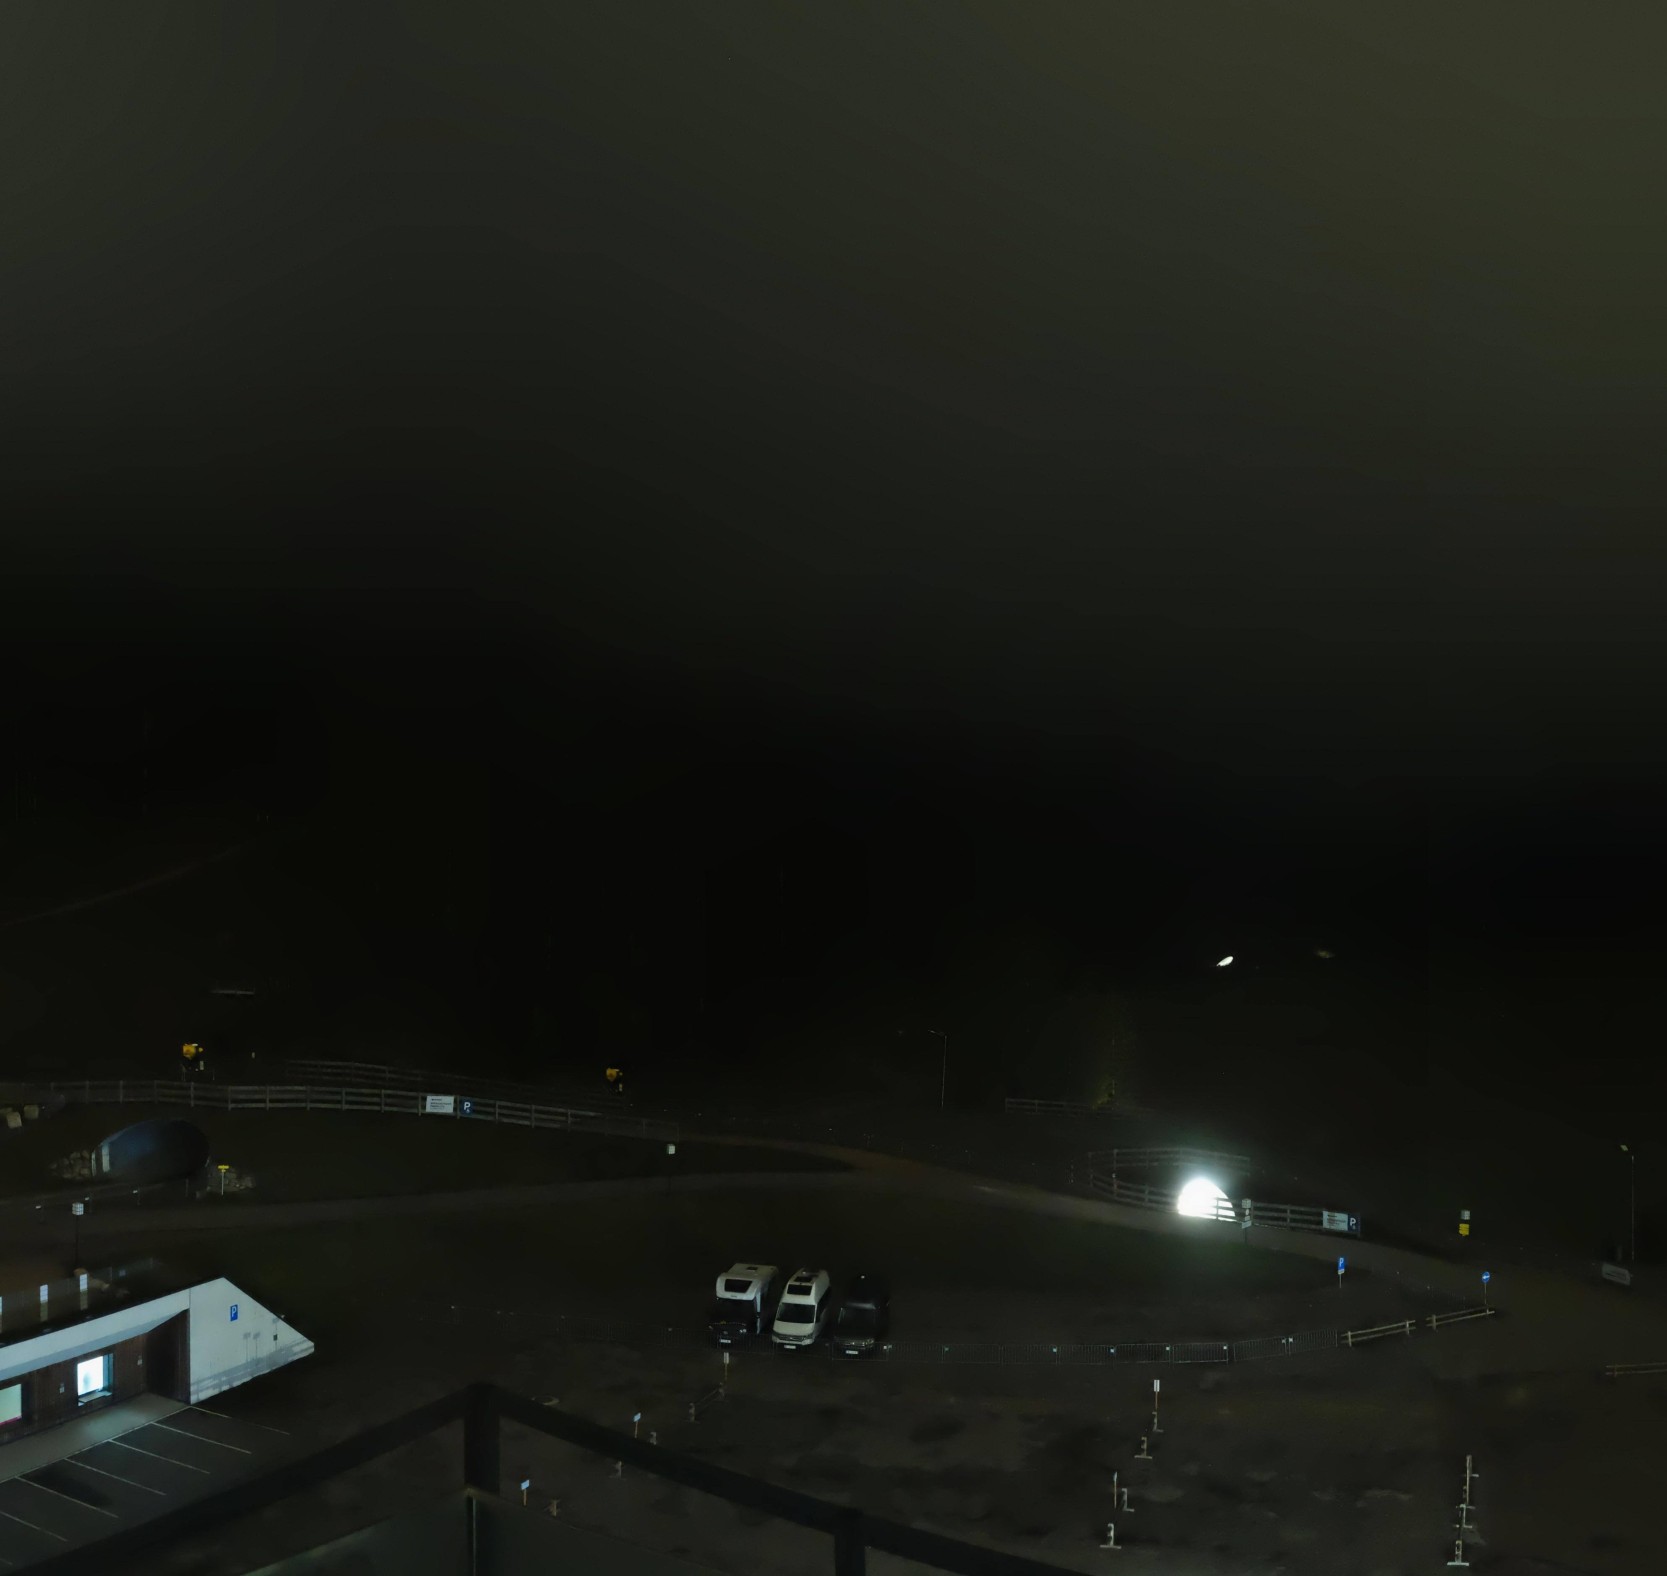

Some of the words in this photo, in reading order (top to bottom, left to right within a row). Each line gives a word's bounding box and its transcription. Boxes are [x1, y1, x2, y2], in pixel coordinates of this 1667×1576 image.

[463, 1101, 471, 1111] P
[1349, 1217, 1357, 1227] P
[231, 1305, 237, 1318] P
